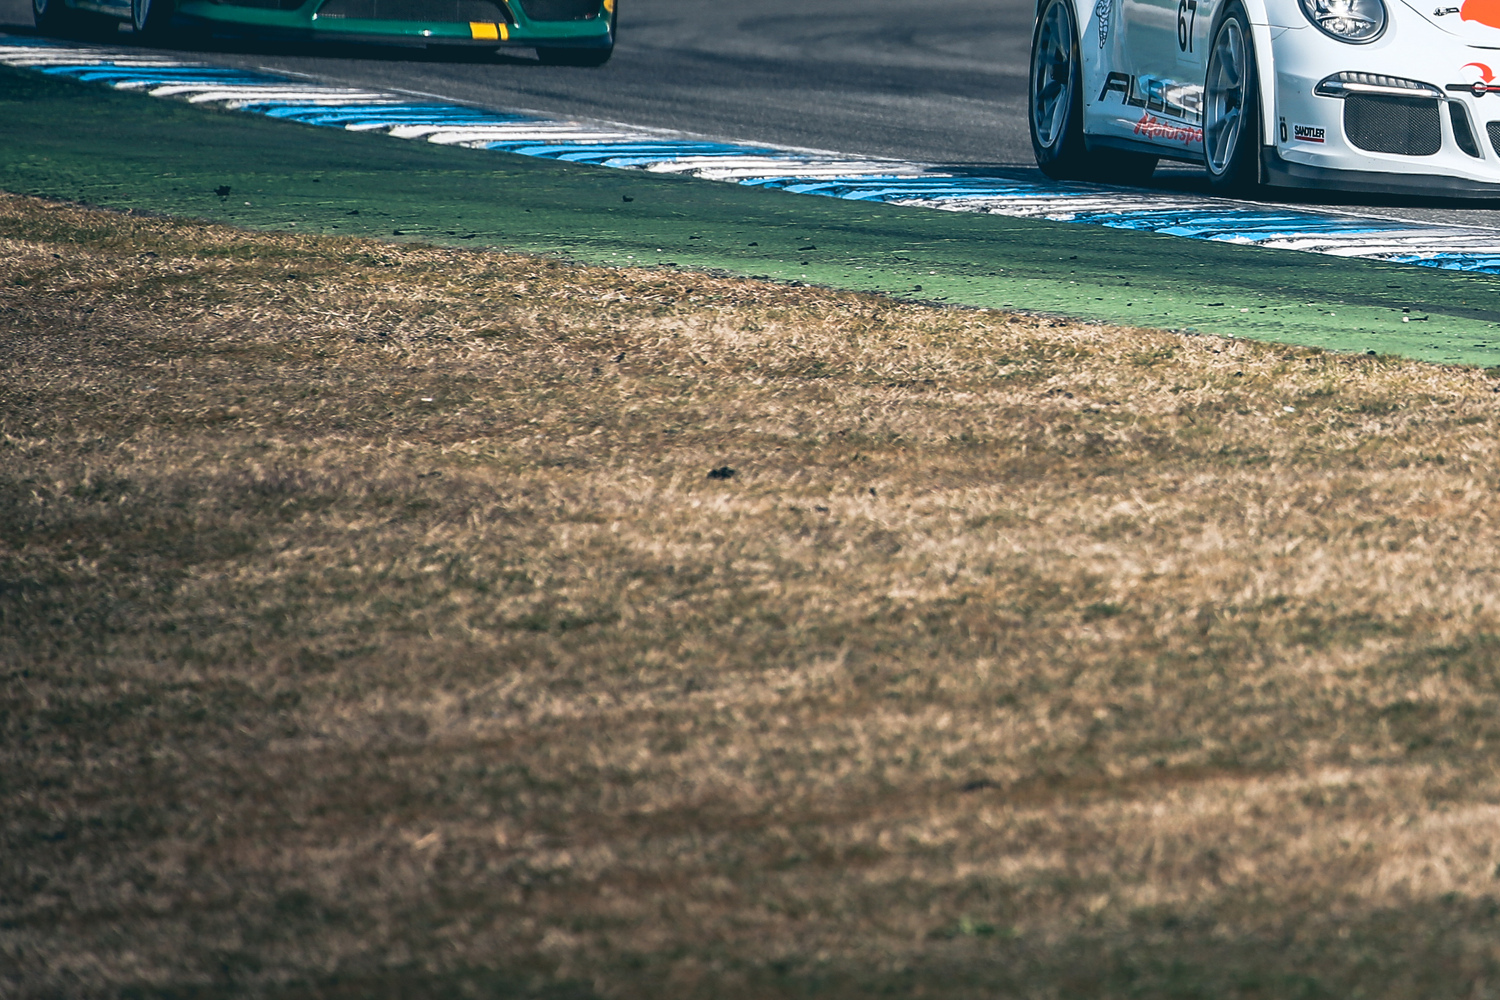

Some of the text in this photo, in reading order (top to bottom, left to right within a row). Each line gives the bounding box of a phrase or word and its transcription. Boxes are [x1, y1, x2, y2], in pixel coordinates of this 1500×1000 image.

[1098, 71, 1202, 123] ALBER
[1133, 113, 1203, 147] Motorspo
[1294, 125, 1325, 138] SANDTLER
